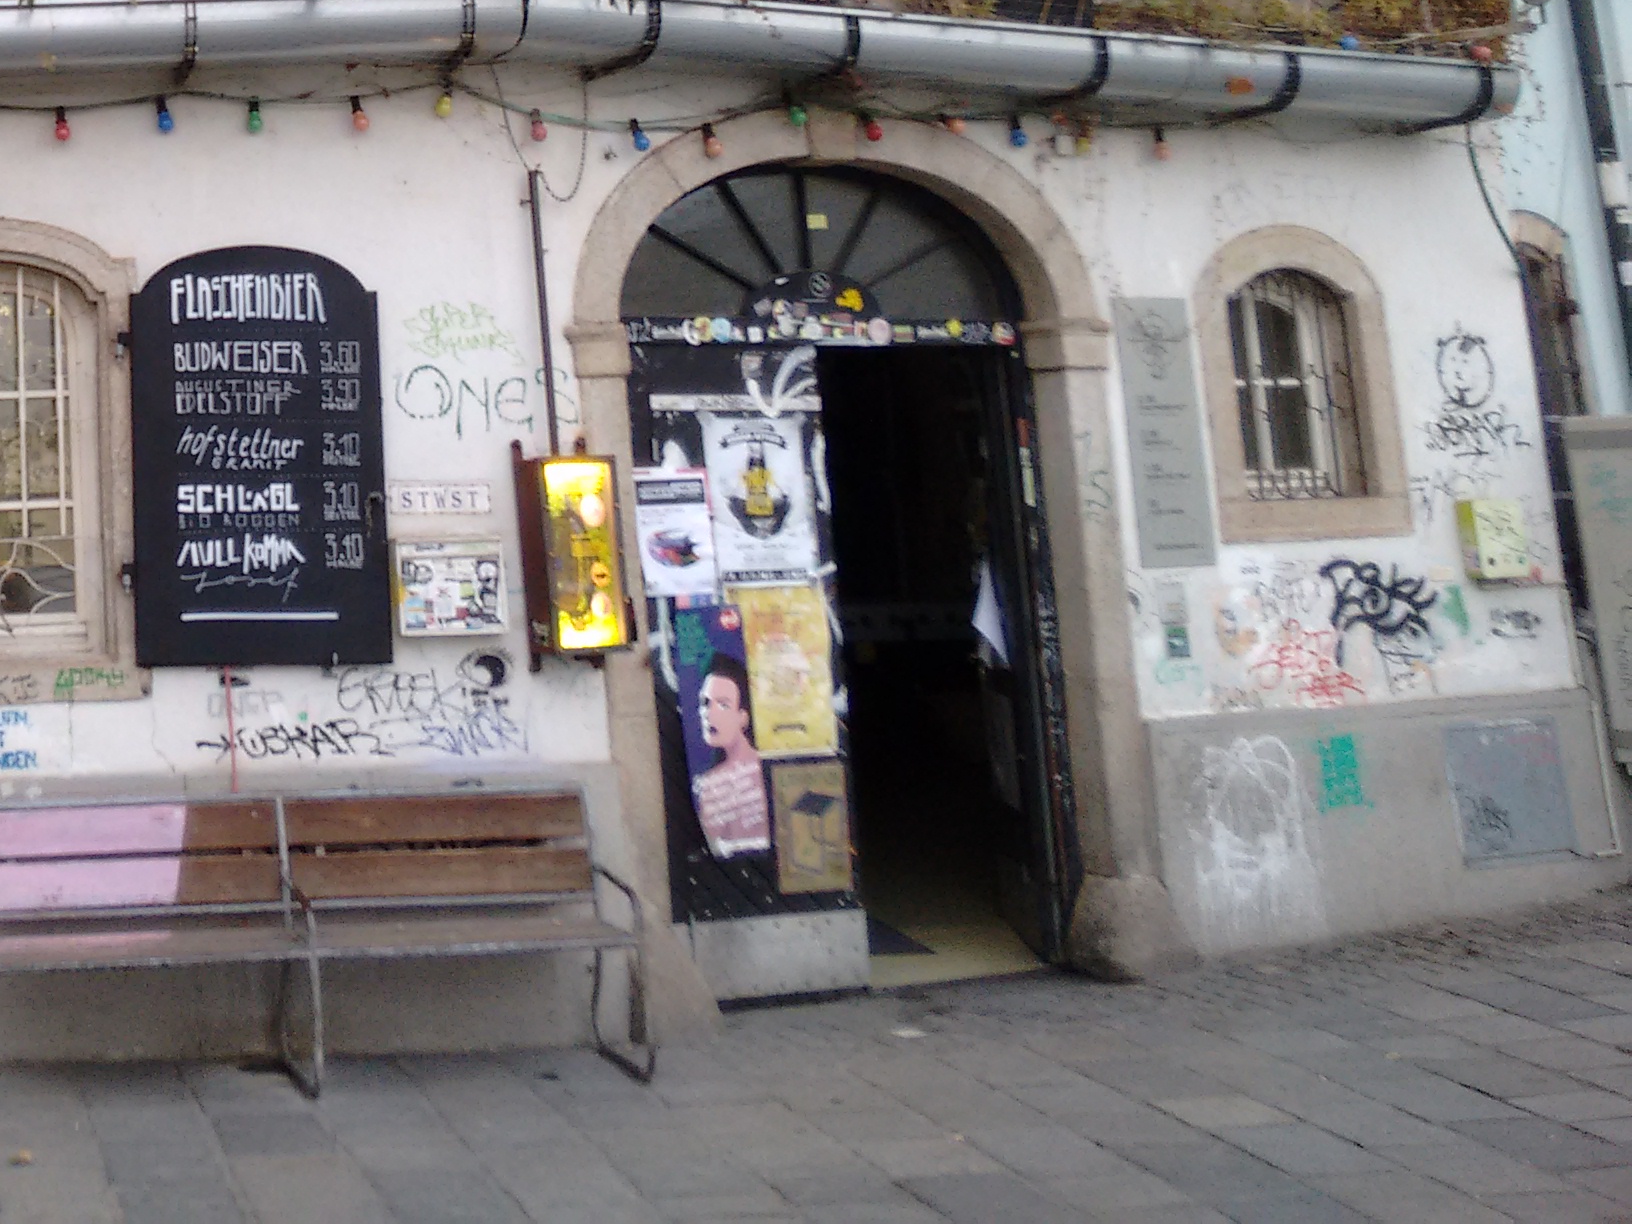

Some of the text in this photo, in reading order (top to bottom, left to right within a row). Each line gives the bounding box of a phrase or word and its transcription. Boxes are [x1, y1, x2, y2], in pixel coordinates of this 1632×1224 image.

[173, 340, 309, 375] BUDWEISER
[175, 379, 301, 395] AUGUSTINER
[175, 392, 292, 415] EDELSTOFF
[400, 490, 480, 509] STWST
